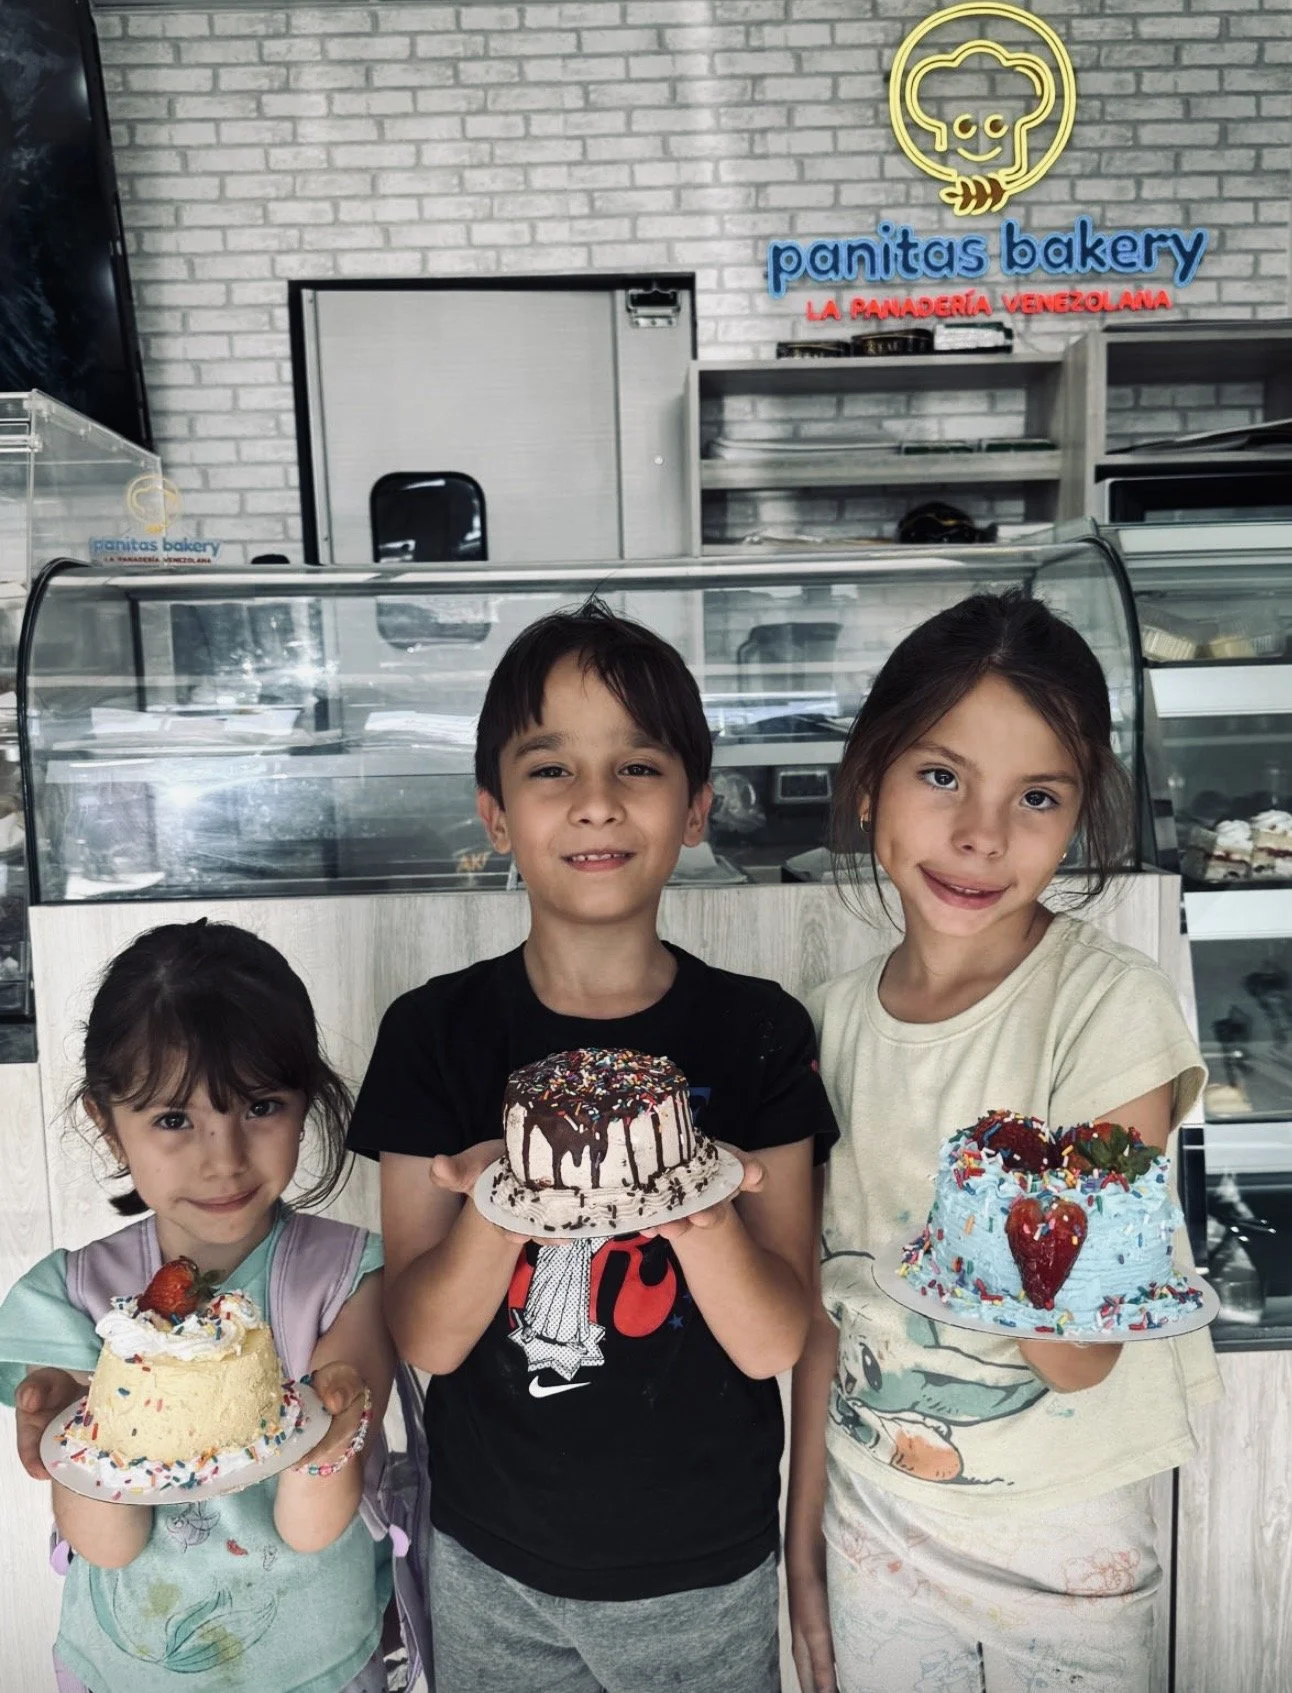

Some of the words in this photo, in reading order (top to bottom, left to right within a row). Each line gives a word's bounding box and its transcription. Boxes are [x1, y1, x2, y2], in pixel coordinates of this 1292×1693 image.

[767, 219, 989, 298] panitas
[1000, 215, 1208, 287] bakery
[806, 299, 841, 321] LA
[850, 288, 992, 320] PANADERÍA
[1002, 288, 1173, 315] VENEZOLANA
[92, 537, 158, 555] panitas
[162, 537, 220, 557] bakery
